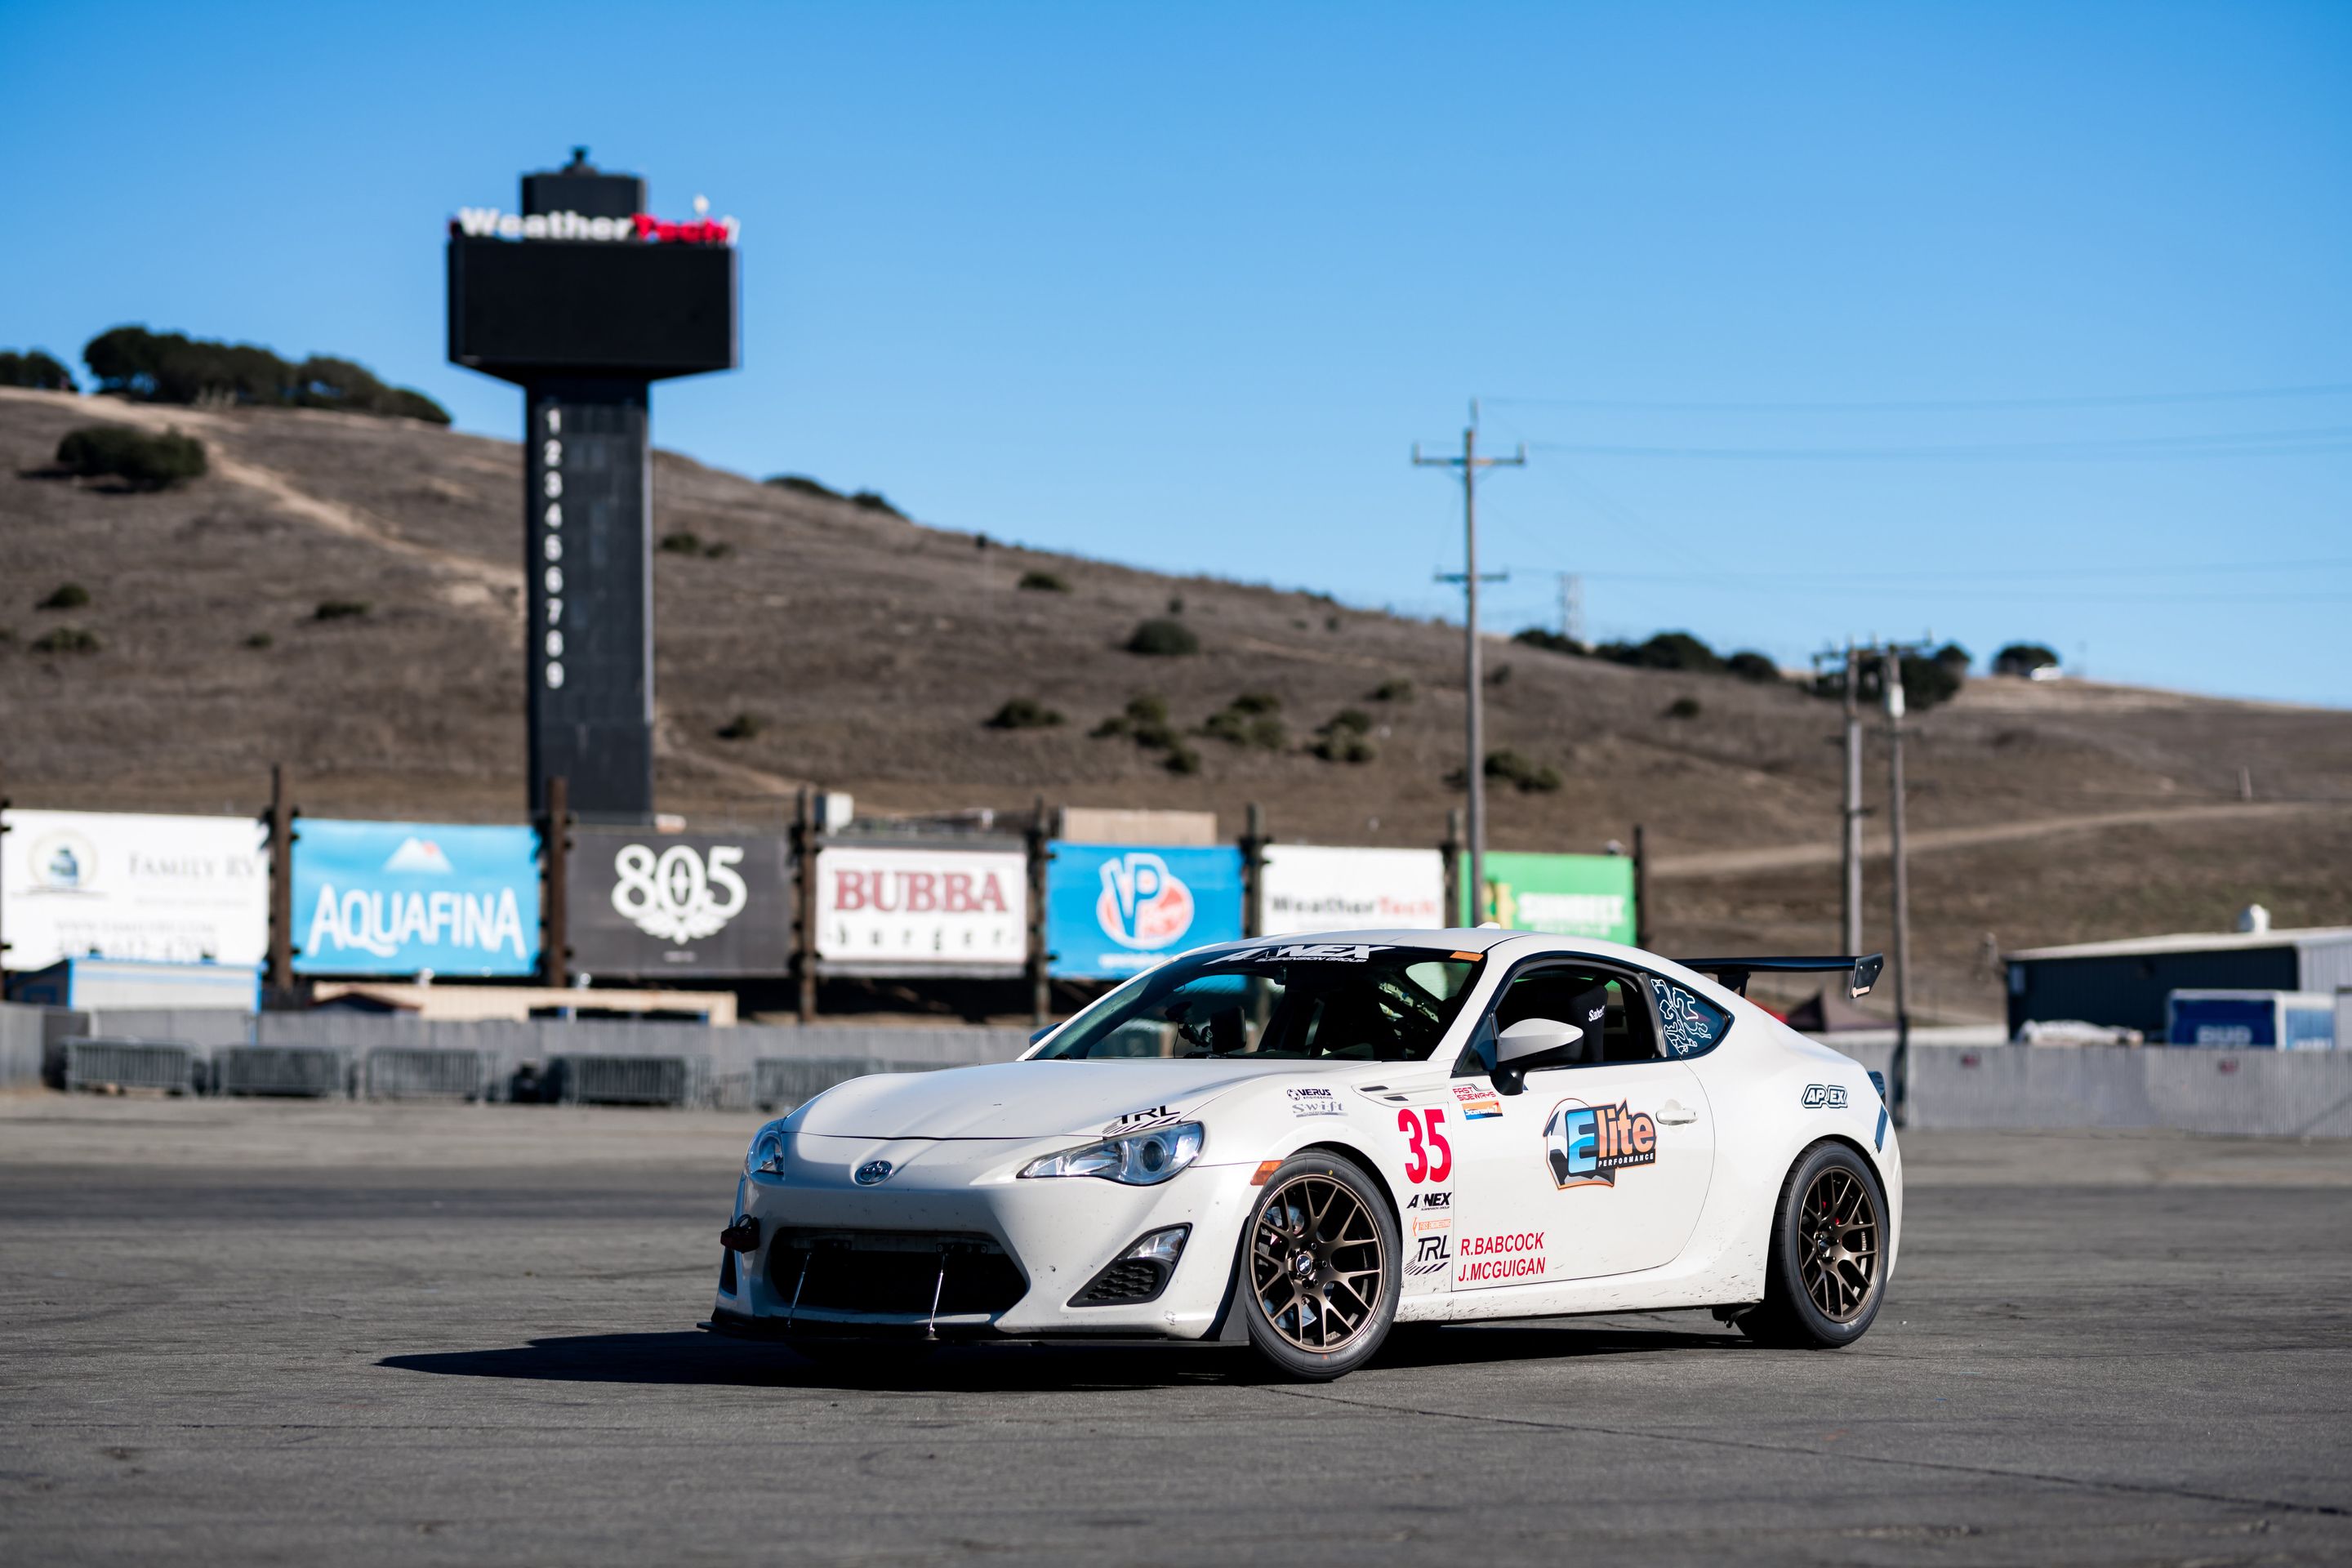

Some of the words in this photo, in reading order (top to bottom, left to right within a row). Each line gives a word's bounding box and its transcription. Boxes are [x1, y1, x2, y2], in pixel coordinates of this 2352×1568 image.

[459, 207, 729, 242] WeatherTech
[546, 408, 561, 434] 1
[544, 439, 563, 466] 2
[544, 470, 563, 499] 3
[545, 501, 563, 530] 4
[545, 533, 563, 562] 5
[545, 565, 564, 595] 6
[546, 598, 564, 626] 7
[546, 629, 564, 657] 8
[546, 661, 565, 689] 9
[612, 844, 747, 920] 805
[835, 870, 1008, 912] BUBBA
[1099, 853, 1169, 940] VP
[1271, 893, 1436, 915] WeatherTech
[306, 882, 527, 959] AQUAFINA
[1453, 1086, 1473, 1095] FAST
[1457, 1091, 1496, 1101] SIDEWAYS
[1804, 1087, 1846, 1105] APEX
[1114, 1105, 1181, 1125] TRL
[1292, 1101, 1344, 1113] Swift
[1397, 1108, 1452, 1184] 35
[1567, 1107, 1655, 1174] Elite
[1597, 1152, 1655, 1168] PERFORMANCE
[1418, 1234, 1451, 1263] TRL
[1460, 1232, 1545, 1257] R.BABCOCK
[1458, 1256, 1546, 1282] J.MCGUIGAN
